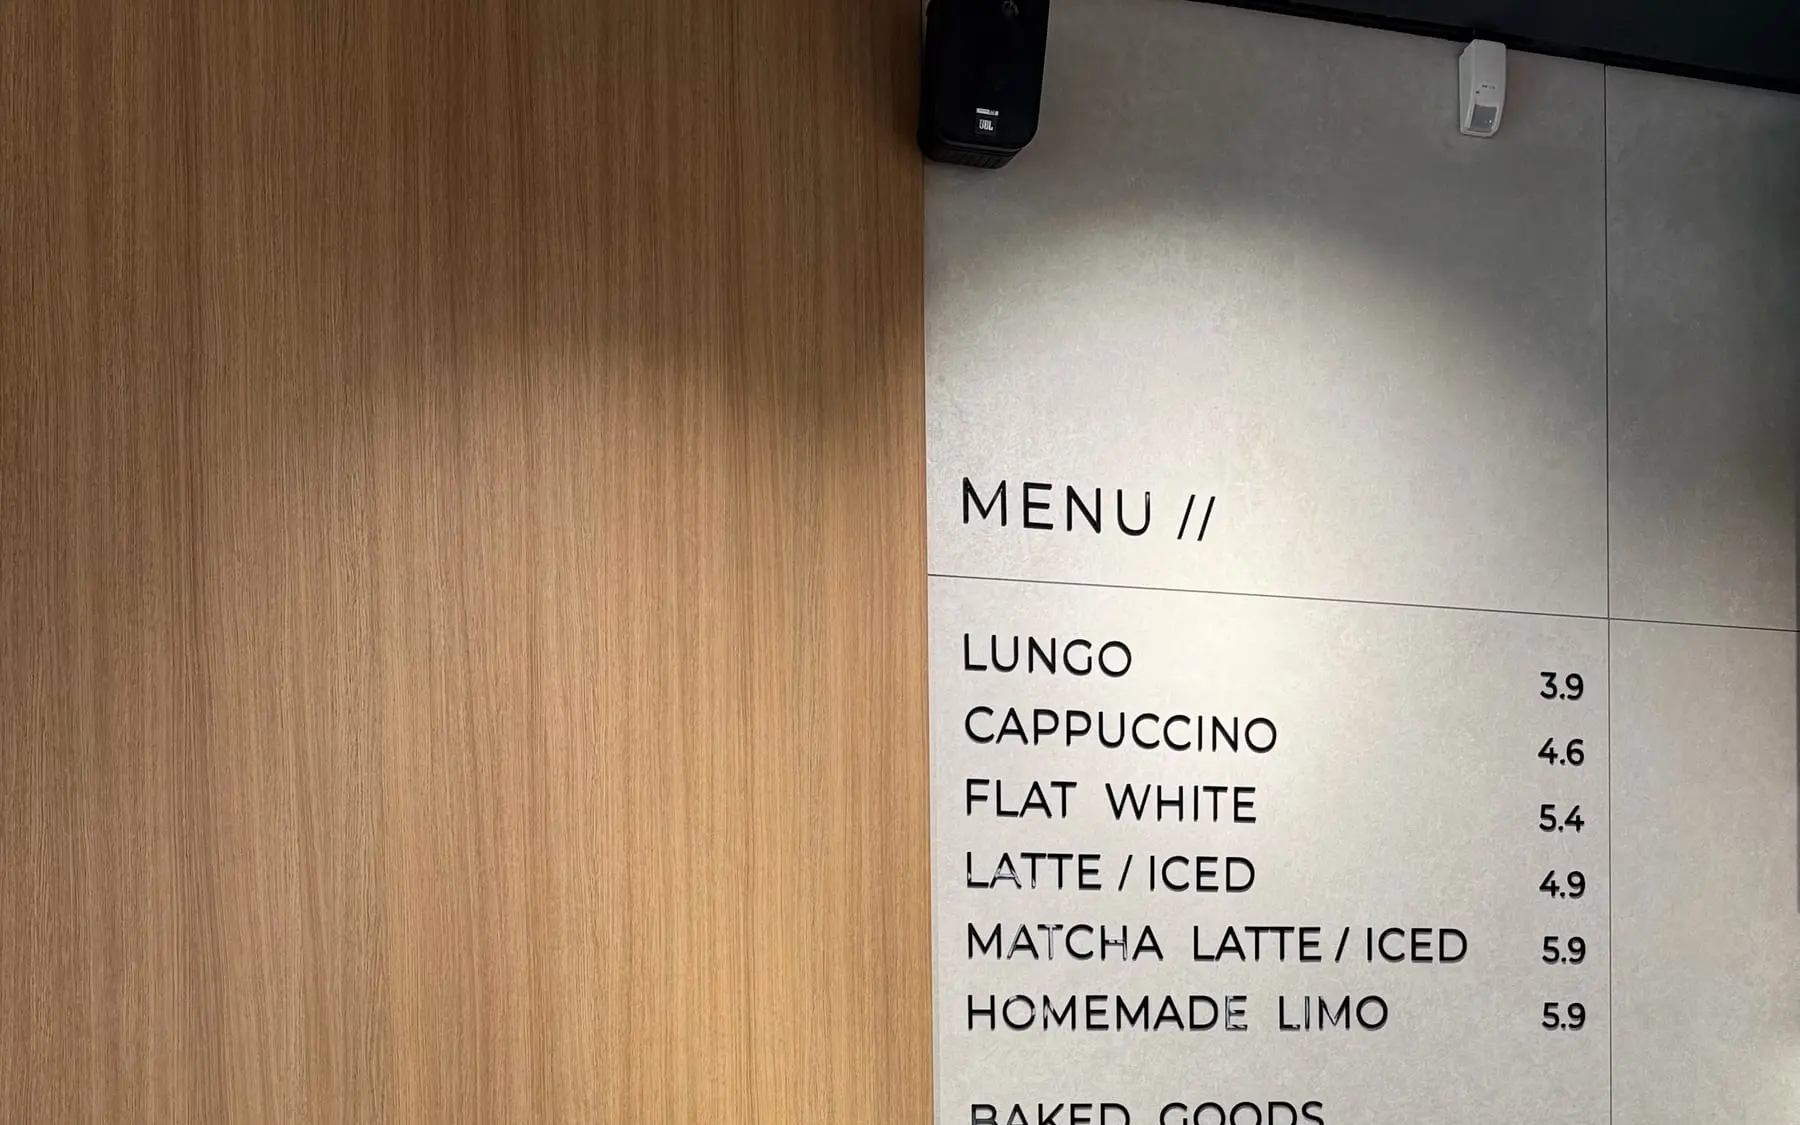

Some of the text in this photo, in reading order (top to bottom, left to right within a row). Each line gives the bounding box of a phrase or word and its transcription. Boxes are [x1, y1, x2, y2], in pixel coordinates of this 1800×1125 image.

[963, 476, 1151, 537] MENU
[963, 632, 1585, 702] LUNGO 3.9
[964, 705, 1585, 767] CAPPUCCINO 4.6
[965, 777, 1585, 834] FLAT WHITE 5.4
[966, 851, 1103, 891] LATTE
[1149, 854, 1256, 894] ICED
[1538, 869, 1586, 900] 4.9
[967, 922, 1164, 963] MATCHA
[1193, 925, 1323, 963] LATTE
[1366, 926, 1468, 964] ICED
[1541, 935, 1587, 966] 5.9
[967, 994, 1586, 1033] HOMEMADE LIMO 5.9
